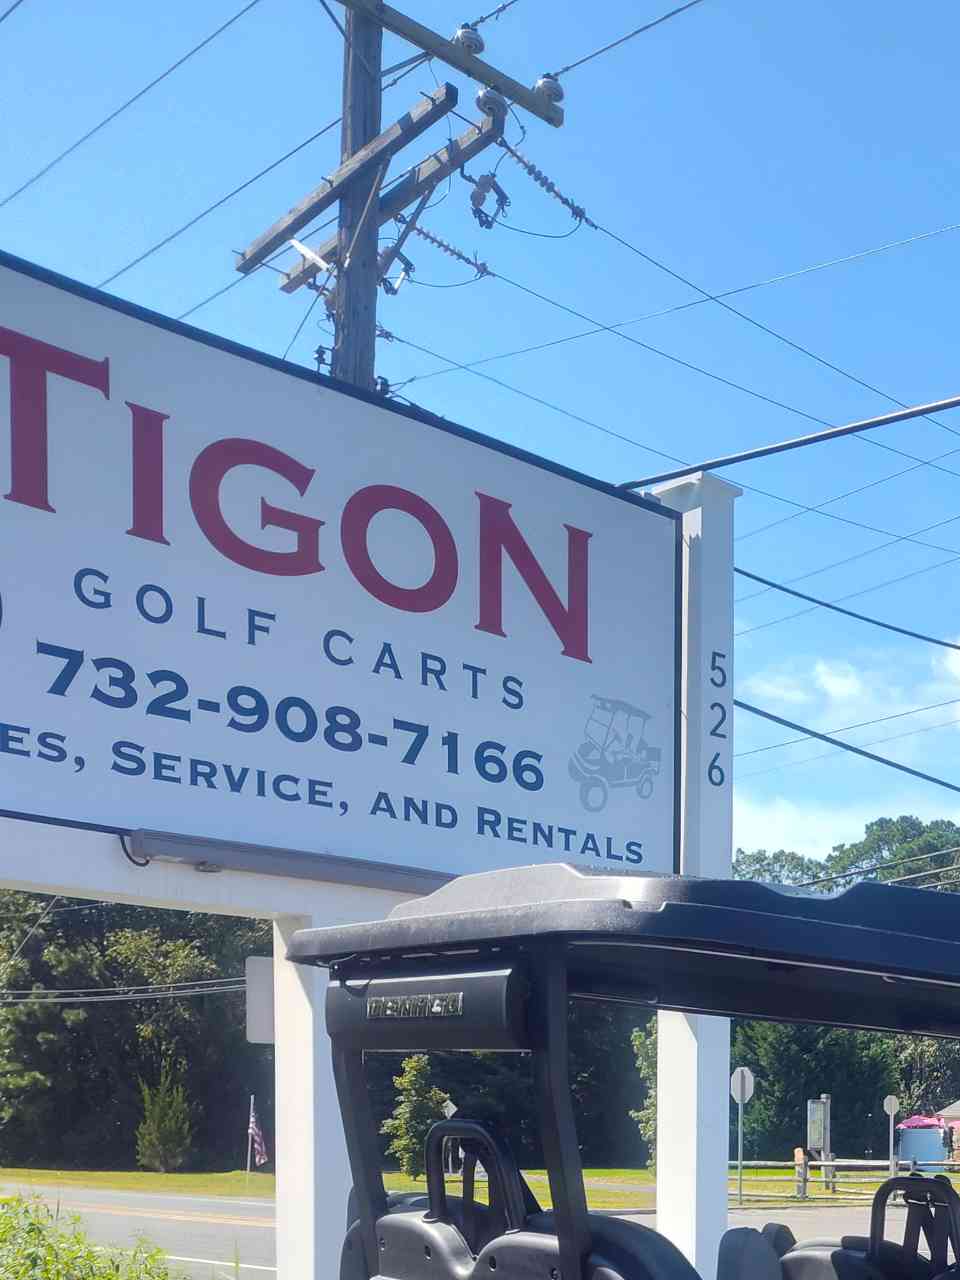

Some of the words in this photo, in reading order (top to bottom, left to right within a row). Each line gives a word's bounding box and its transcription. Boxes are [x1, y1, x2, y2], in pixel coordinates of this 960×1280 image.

[0, 324, 595, 665] TIGON
[72, 566, 278, 647] GOLF
[322, 628, 526, 711] CARTS
[35, 638, 545, 793] 732-908-7166
[110, 739, 350, 818] SERVICE,
[369, 790, 459, 830] AND
[476, 805, 645, 865] RENTALS
